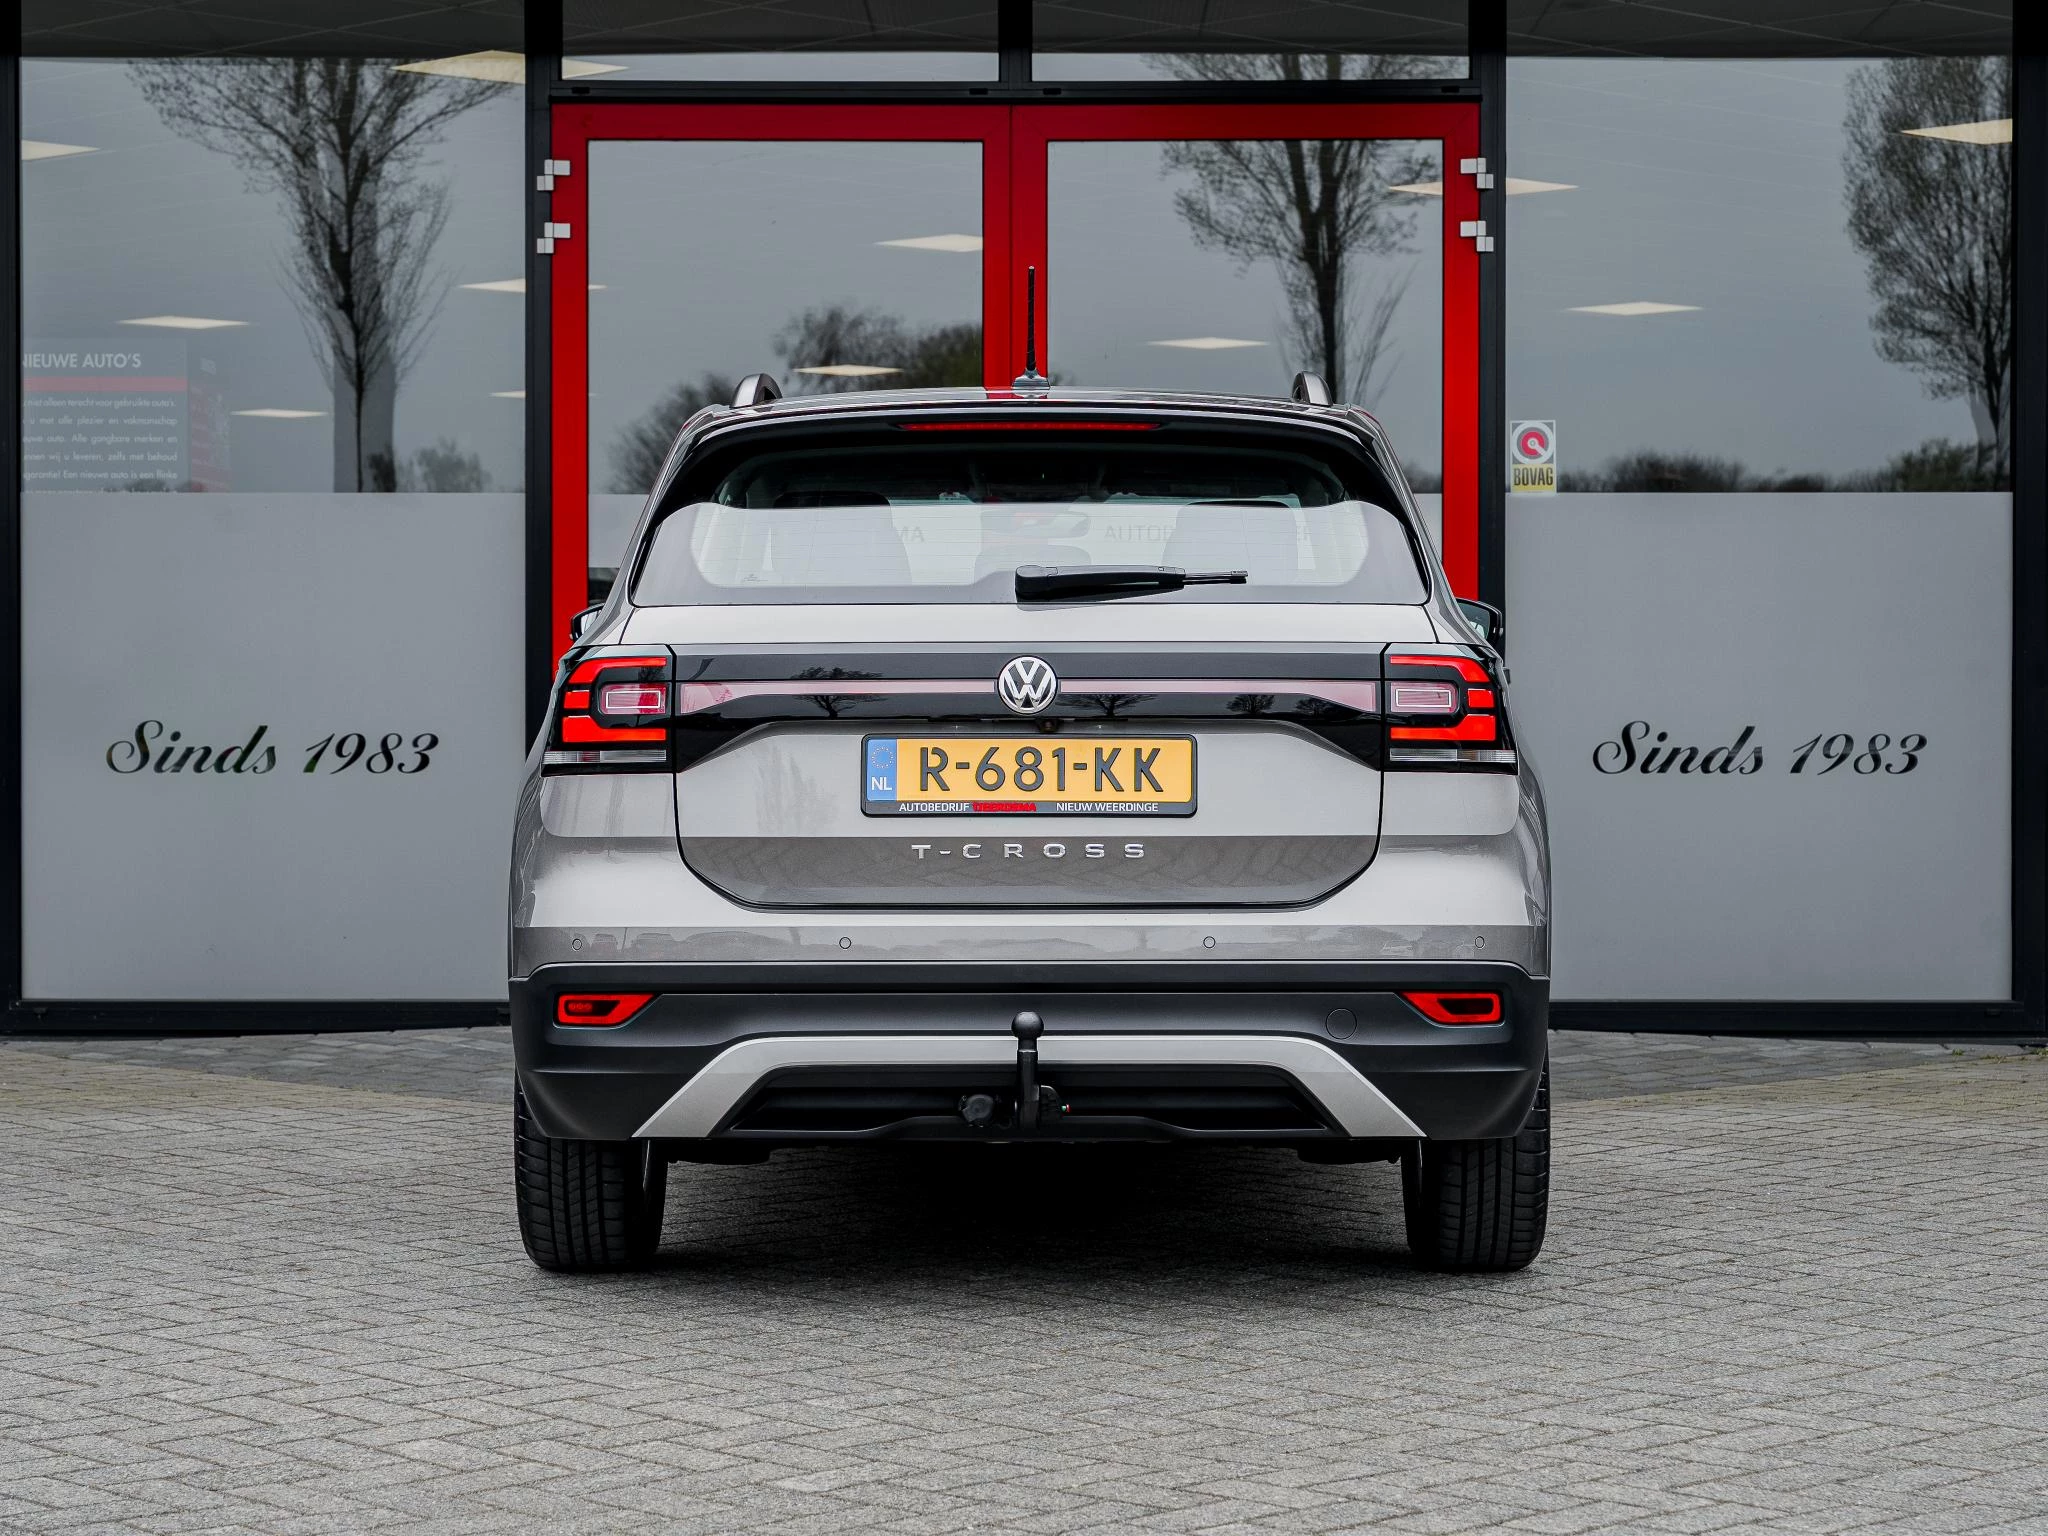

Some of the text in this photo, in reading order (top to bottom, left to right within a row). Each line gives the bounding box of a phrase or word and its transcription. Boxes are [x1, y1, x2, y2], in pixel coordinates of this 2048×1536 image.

[82, 353, 142, 369] AUTO'S
[76, 416, 104, 428] plezier
[107, 417, 119, 425] en
[123, 416, 178, 428] vakmanschap
[71, 432, 88, 443] Alle
[147, 451, 178, 461] behoud
[111, 471, 129, 479] auto
[139, 471, 154, 479] een
[1513, 467, 1554, 486] BOVAG
[106, 719, 440, 775] Sinds 1983
[1592, 720, 1928, 775] Sinds 1983
[919, 746, 1164, 792] R-681-KK
[871, 776, 893, 791] NL
[898, 802, 970, 813] AUTOBEDRIJF
[1055, 802, 1092, 813] NIEUW
[1094, 802, 1159, 813] WEERDINGE
[911, 843, 1145, 860] T-CROSS
